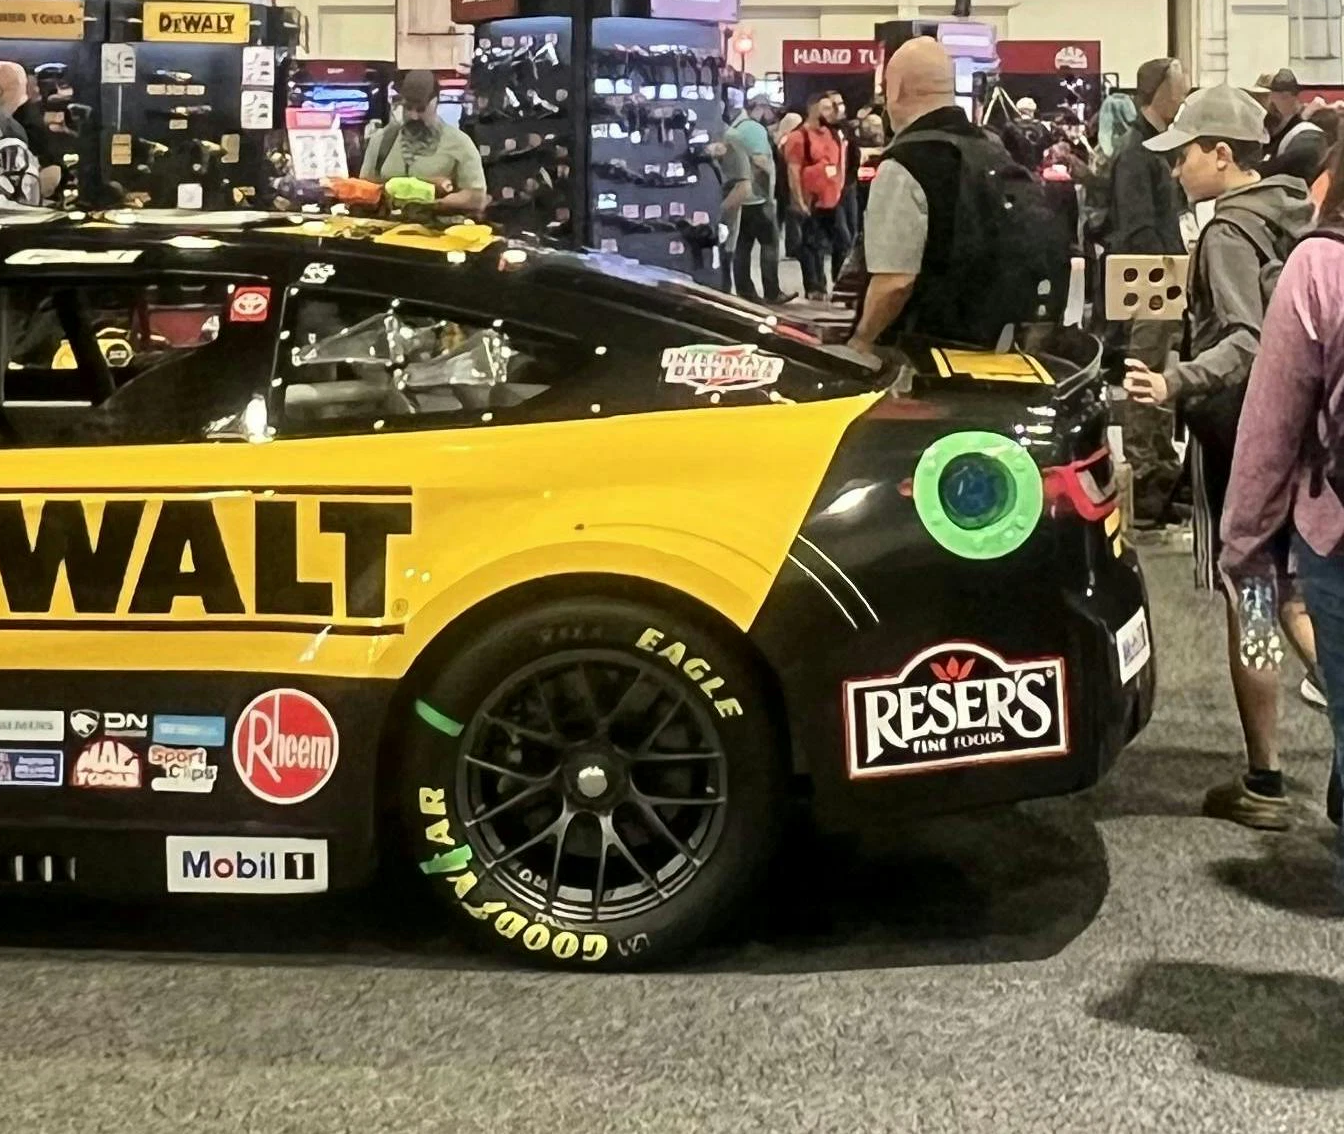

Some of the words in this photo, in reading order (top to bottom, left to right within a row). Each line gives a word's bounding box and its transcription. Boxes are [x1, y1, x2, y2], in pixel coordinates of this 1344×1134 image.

[793, 48, 851, 65] HAND
[635, 627, 744, 719] EAGLE
[864, 670, 1052, 764] RESER'S
[246, 693, 332, 783] Rheem
[182, 850, 276, 879] Mobil
[419, 787, 609, 961] GOODYAR
